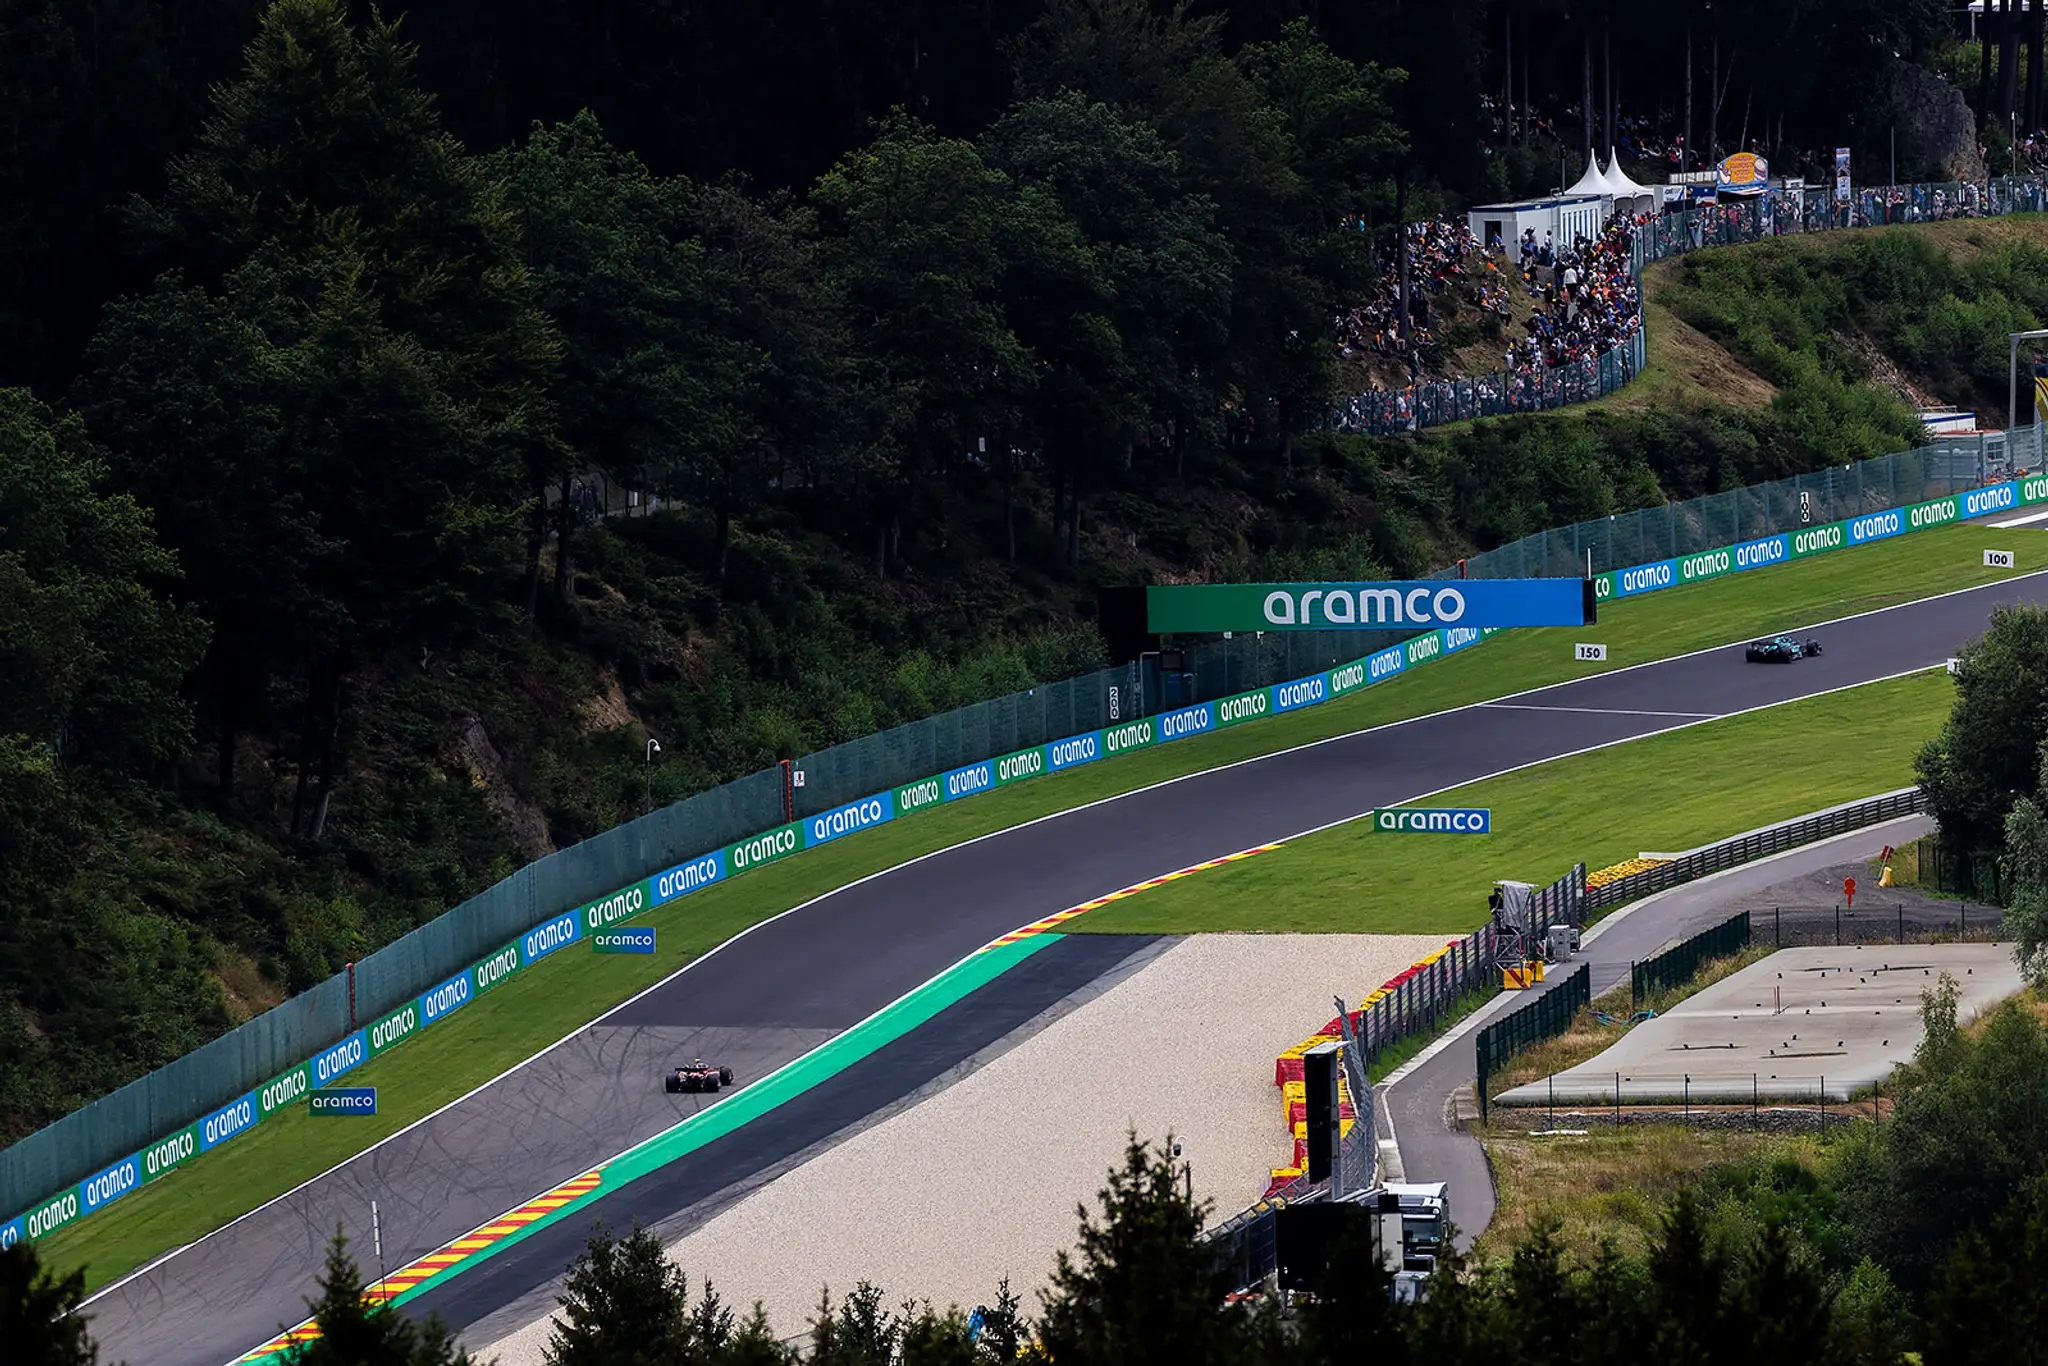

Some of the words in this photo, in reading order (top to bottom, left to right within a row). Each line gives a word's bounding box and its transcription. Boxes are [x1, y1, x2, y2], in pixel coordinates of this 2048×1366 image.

[1967, 486, 2012, 514] aramco
[2024, 478, 2048, 501] ara
[1801, 492, 1809, 520] 100
[1911, 500, 1955, 527] aramco
[1795, 526, 1841, 553] aramco
[1853, 513, 1898, 540] aramco
[1683, 551, 1729, 579] aramco
[1736, 539, 1783, 566] aramco
[1989, 553, 2008, 565] 100
[1623, 564, 1671, 591] aramco
[1263, 587, 1465, 625] aramco
[1371, 649, 1402, 677] aramco
[1408, 635, 1439, 663] aramco
[1580, 647, 1600, 658] 150
[1279, 679, 1323, 707] aramco
[1332, 664, 1363, 693] aramco
[1110, 688, 1118, 717] 200
[1221, 693, 1266, 722] aramco
[1107, 722, 1151, 751] aramco
[1163, 708, 1208, 736] aramco
[999, 751, 1041, 780] aramco
[1052, 737, 1095, 766] aramco
[901, 780, 939, 810] aramco
[949, 766, 988, 795] aramco
[814, 800, 882, 840] aramco
[1379, 812, 1484, 831] aramco
[734, 829, 795, 868] aramco
[659, 858, 717, 898] aramco
[588, 888, 643, 928] aramco
[527, 917, 573, 958] aramco
[595, 935, 653, 946] aramco
[477, 947, 517, 988] aramco
[426, 977, 467, 1018] aramco
[372, 1007, 415, 1049] aramco
[318, 1038, 361, 1081] aramco
[262, 1069, 306, 1112] aramco
[312, 1096, 373, 1108] aramco
[206, 1100, 251, 1143] aramco
[147, 1132, 193, 1174] aramco
[87, 1162, 134, 1206] aramco
[28, 1193, 77, 1238] aramco
